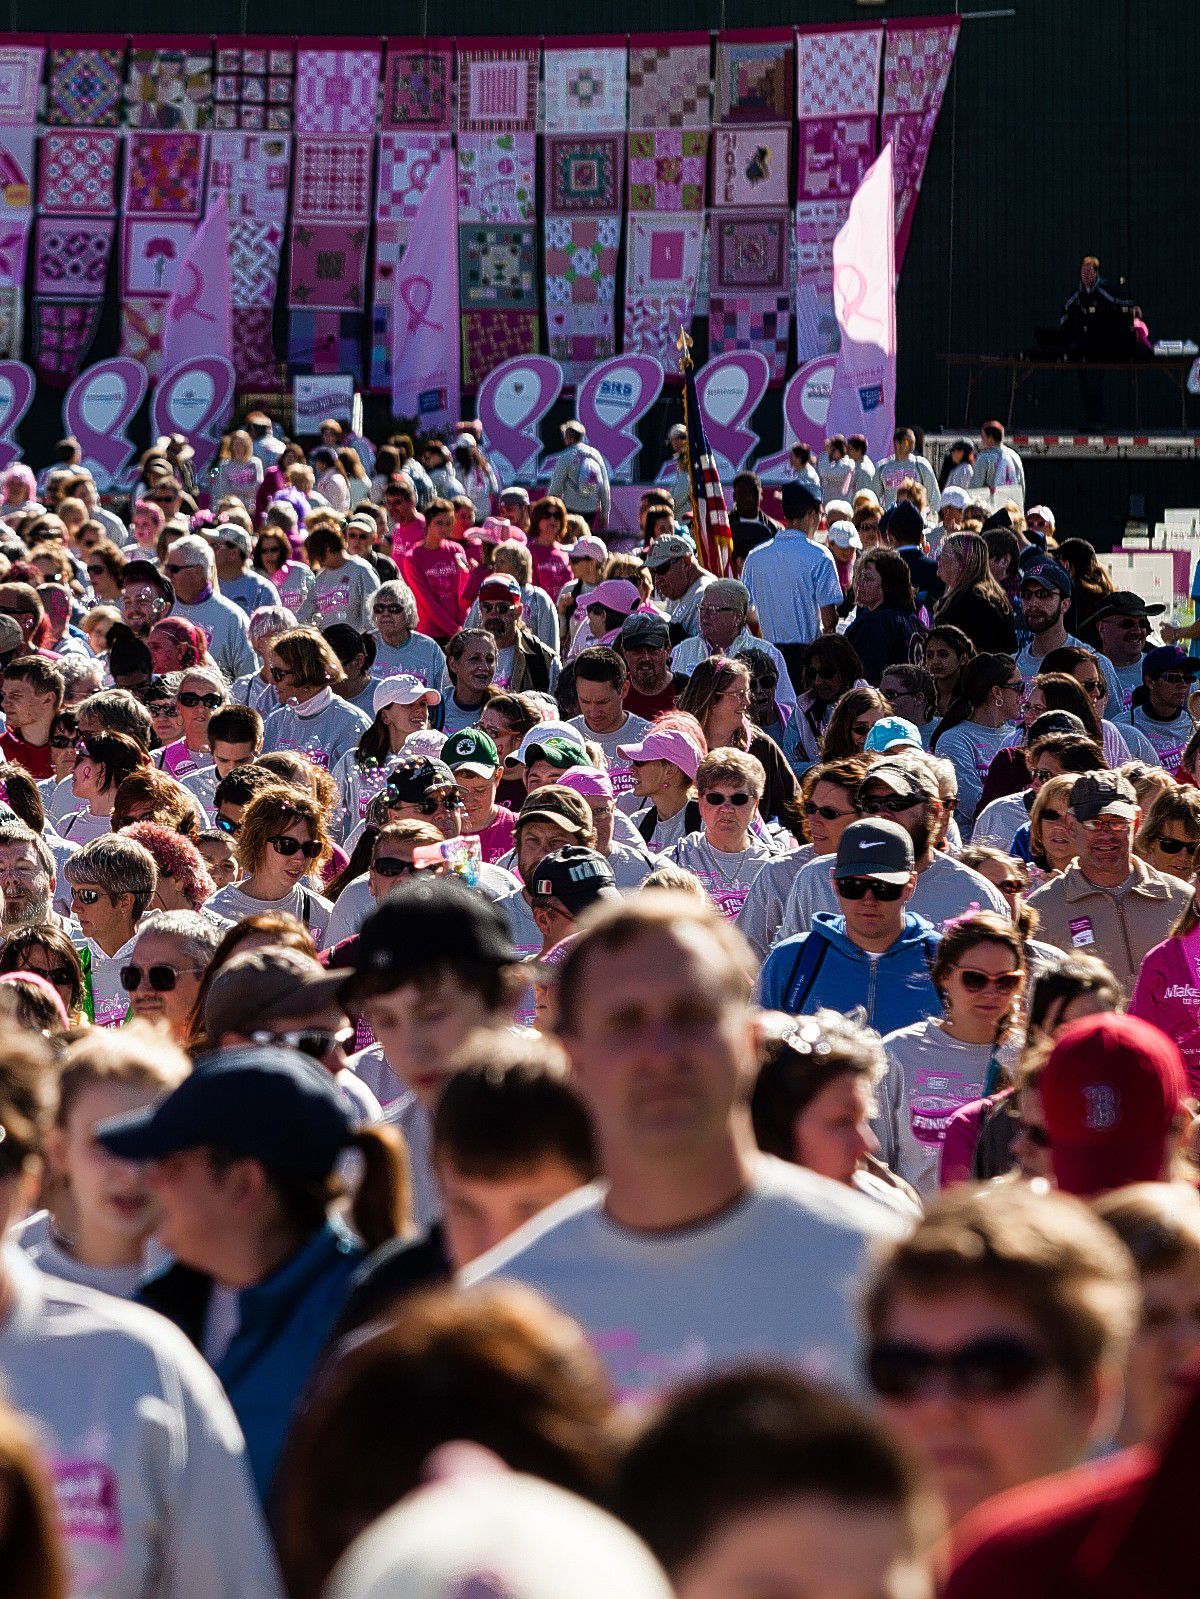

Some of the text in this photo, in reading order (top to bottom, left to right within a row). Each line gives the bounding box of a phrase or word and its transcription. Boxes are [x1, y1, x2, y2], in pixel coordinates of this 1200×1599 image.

[613, 774, 635, 785] FIGH
[1164, 983, 1200, 999] Make
[1079, 1085, 1121, 1131] B
